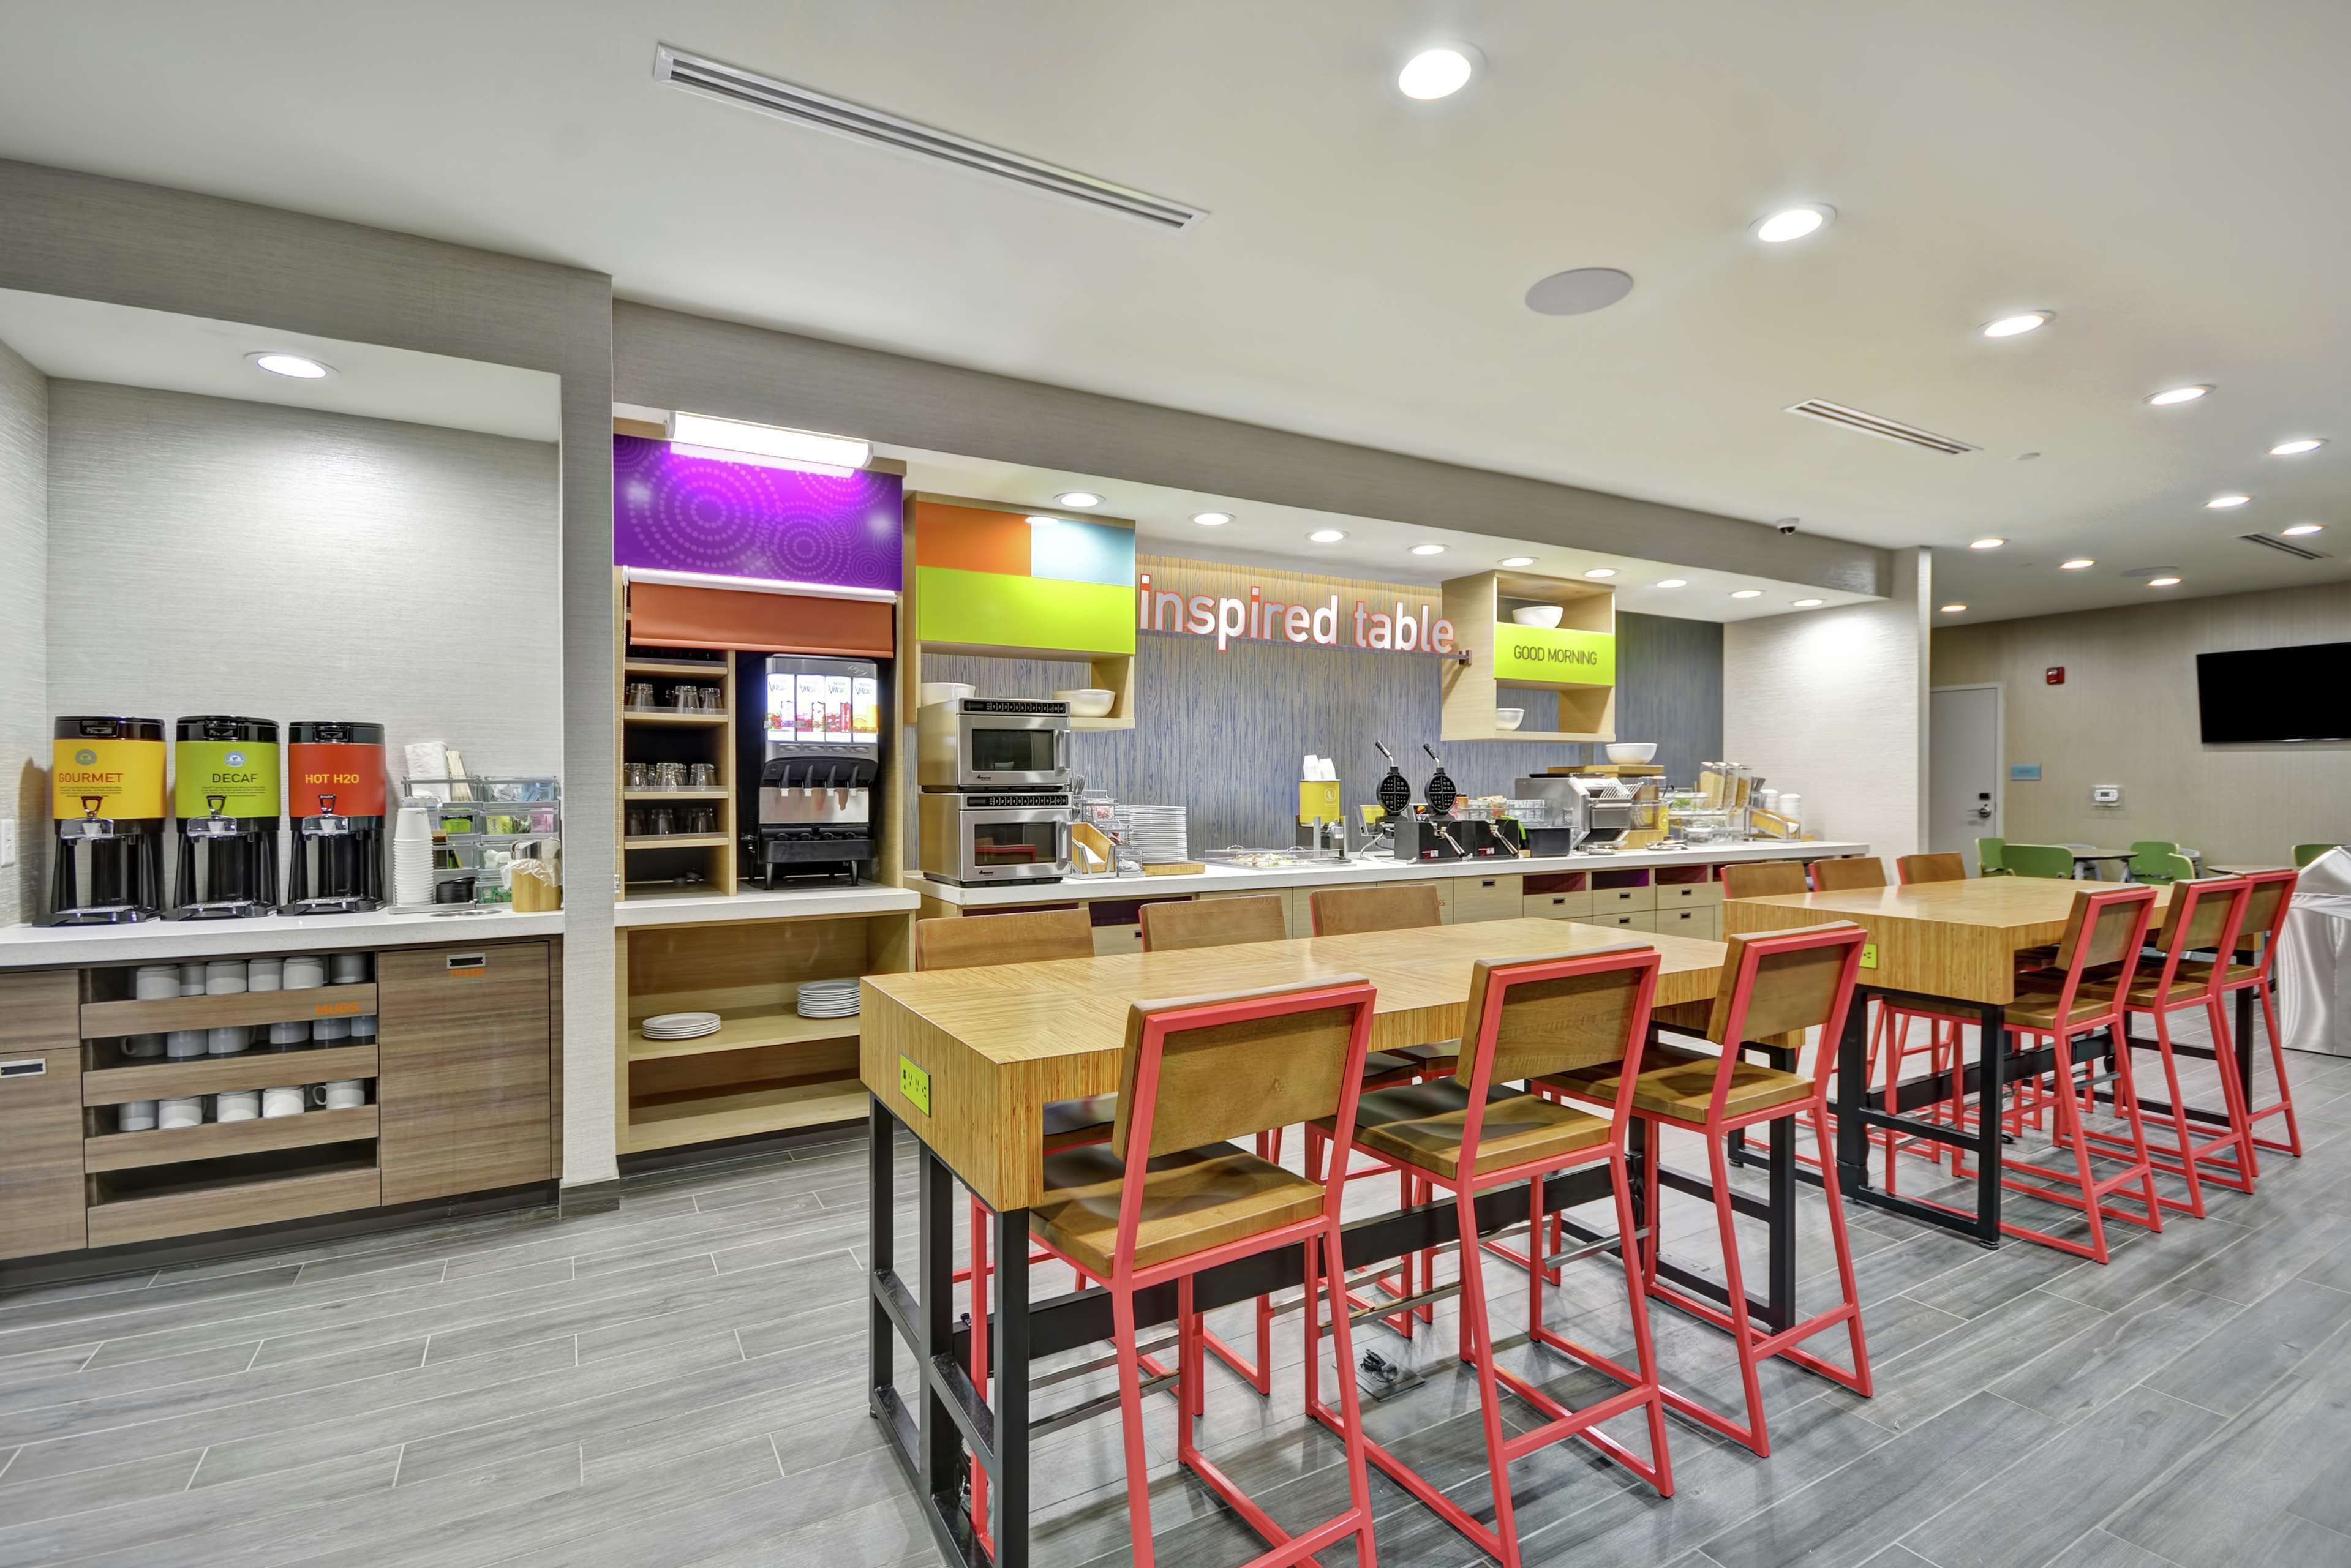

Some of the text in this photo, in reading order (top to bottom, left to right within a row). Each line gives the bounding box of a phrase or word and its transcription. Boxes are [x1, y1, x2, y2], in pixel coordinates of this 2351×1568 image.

[1139, 573, 1456, 655] inspired table
[1514, 645, 1597, 666] GOOD MORNING
[58, 772, 124, 783] GOURMET
[212, 773, 258, 784] DECAF
[305, 773, 330, 784] HOT
[316, 1000, 361, 1015] MUGS
